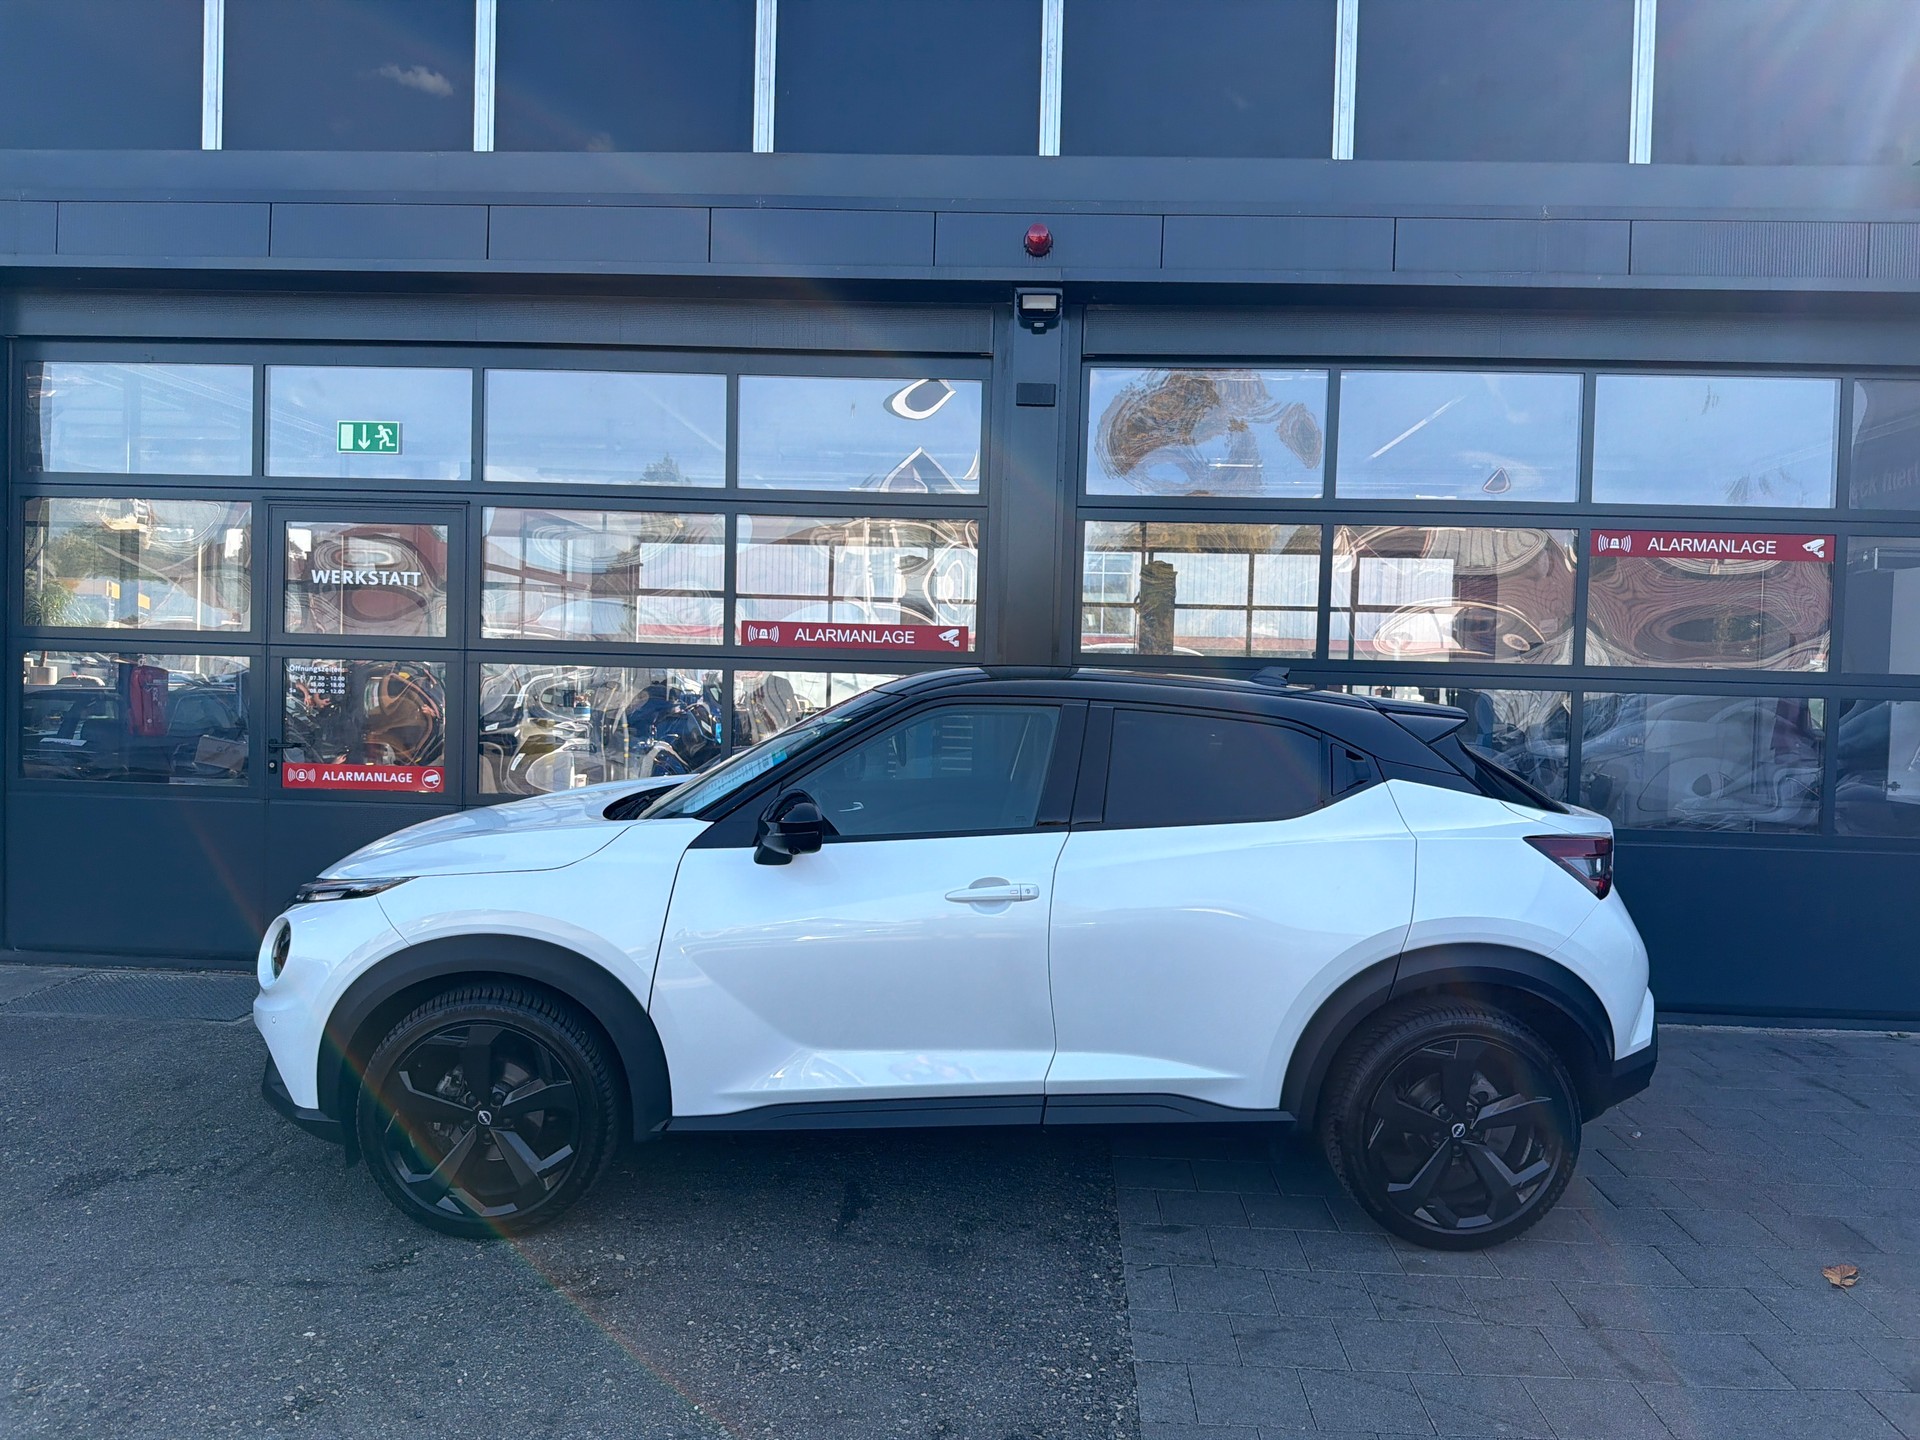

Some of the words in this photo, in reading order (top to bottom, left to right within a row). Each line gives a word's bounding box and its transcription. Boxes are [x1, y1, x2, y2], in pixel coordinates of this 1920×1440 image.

[1646, 536, 1778, 555] ALARMANLAGE
[310, 568, 422, 587] WERKSTATT
[794, 627, 916, 644] ALARMANLAGE
[321, 770, 413, 784] ALARMANLAGE
